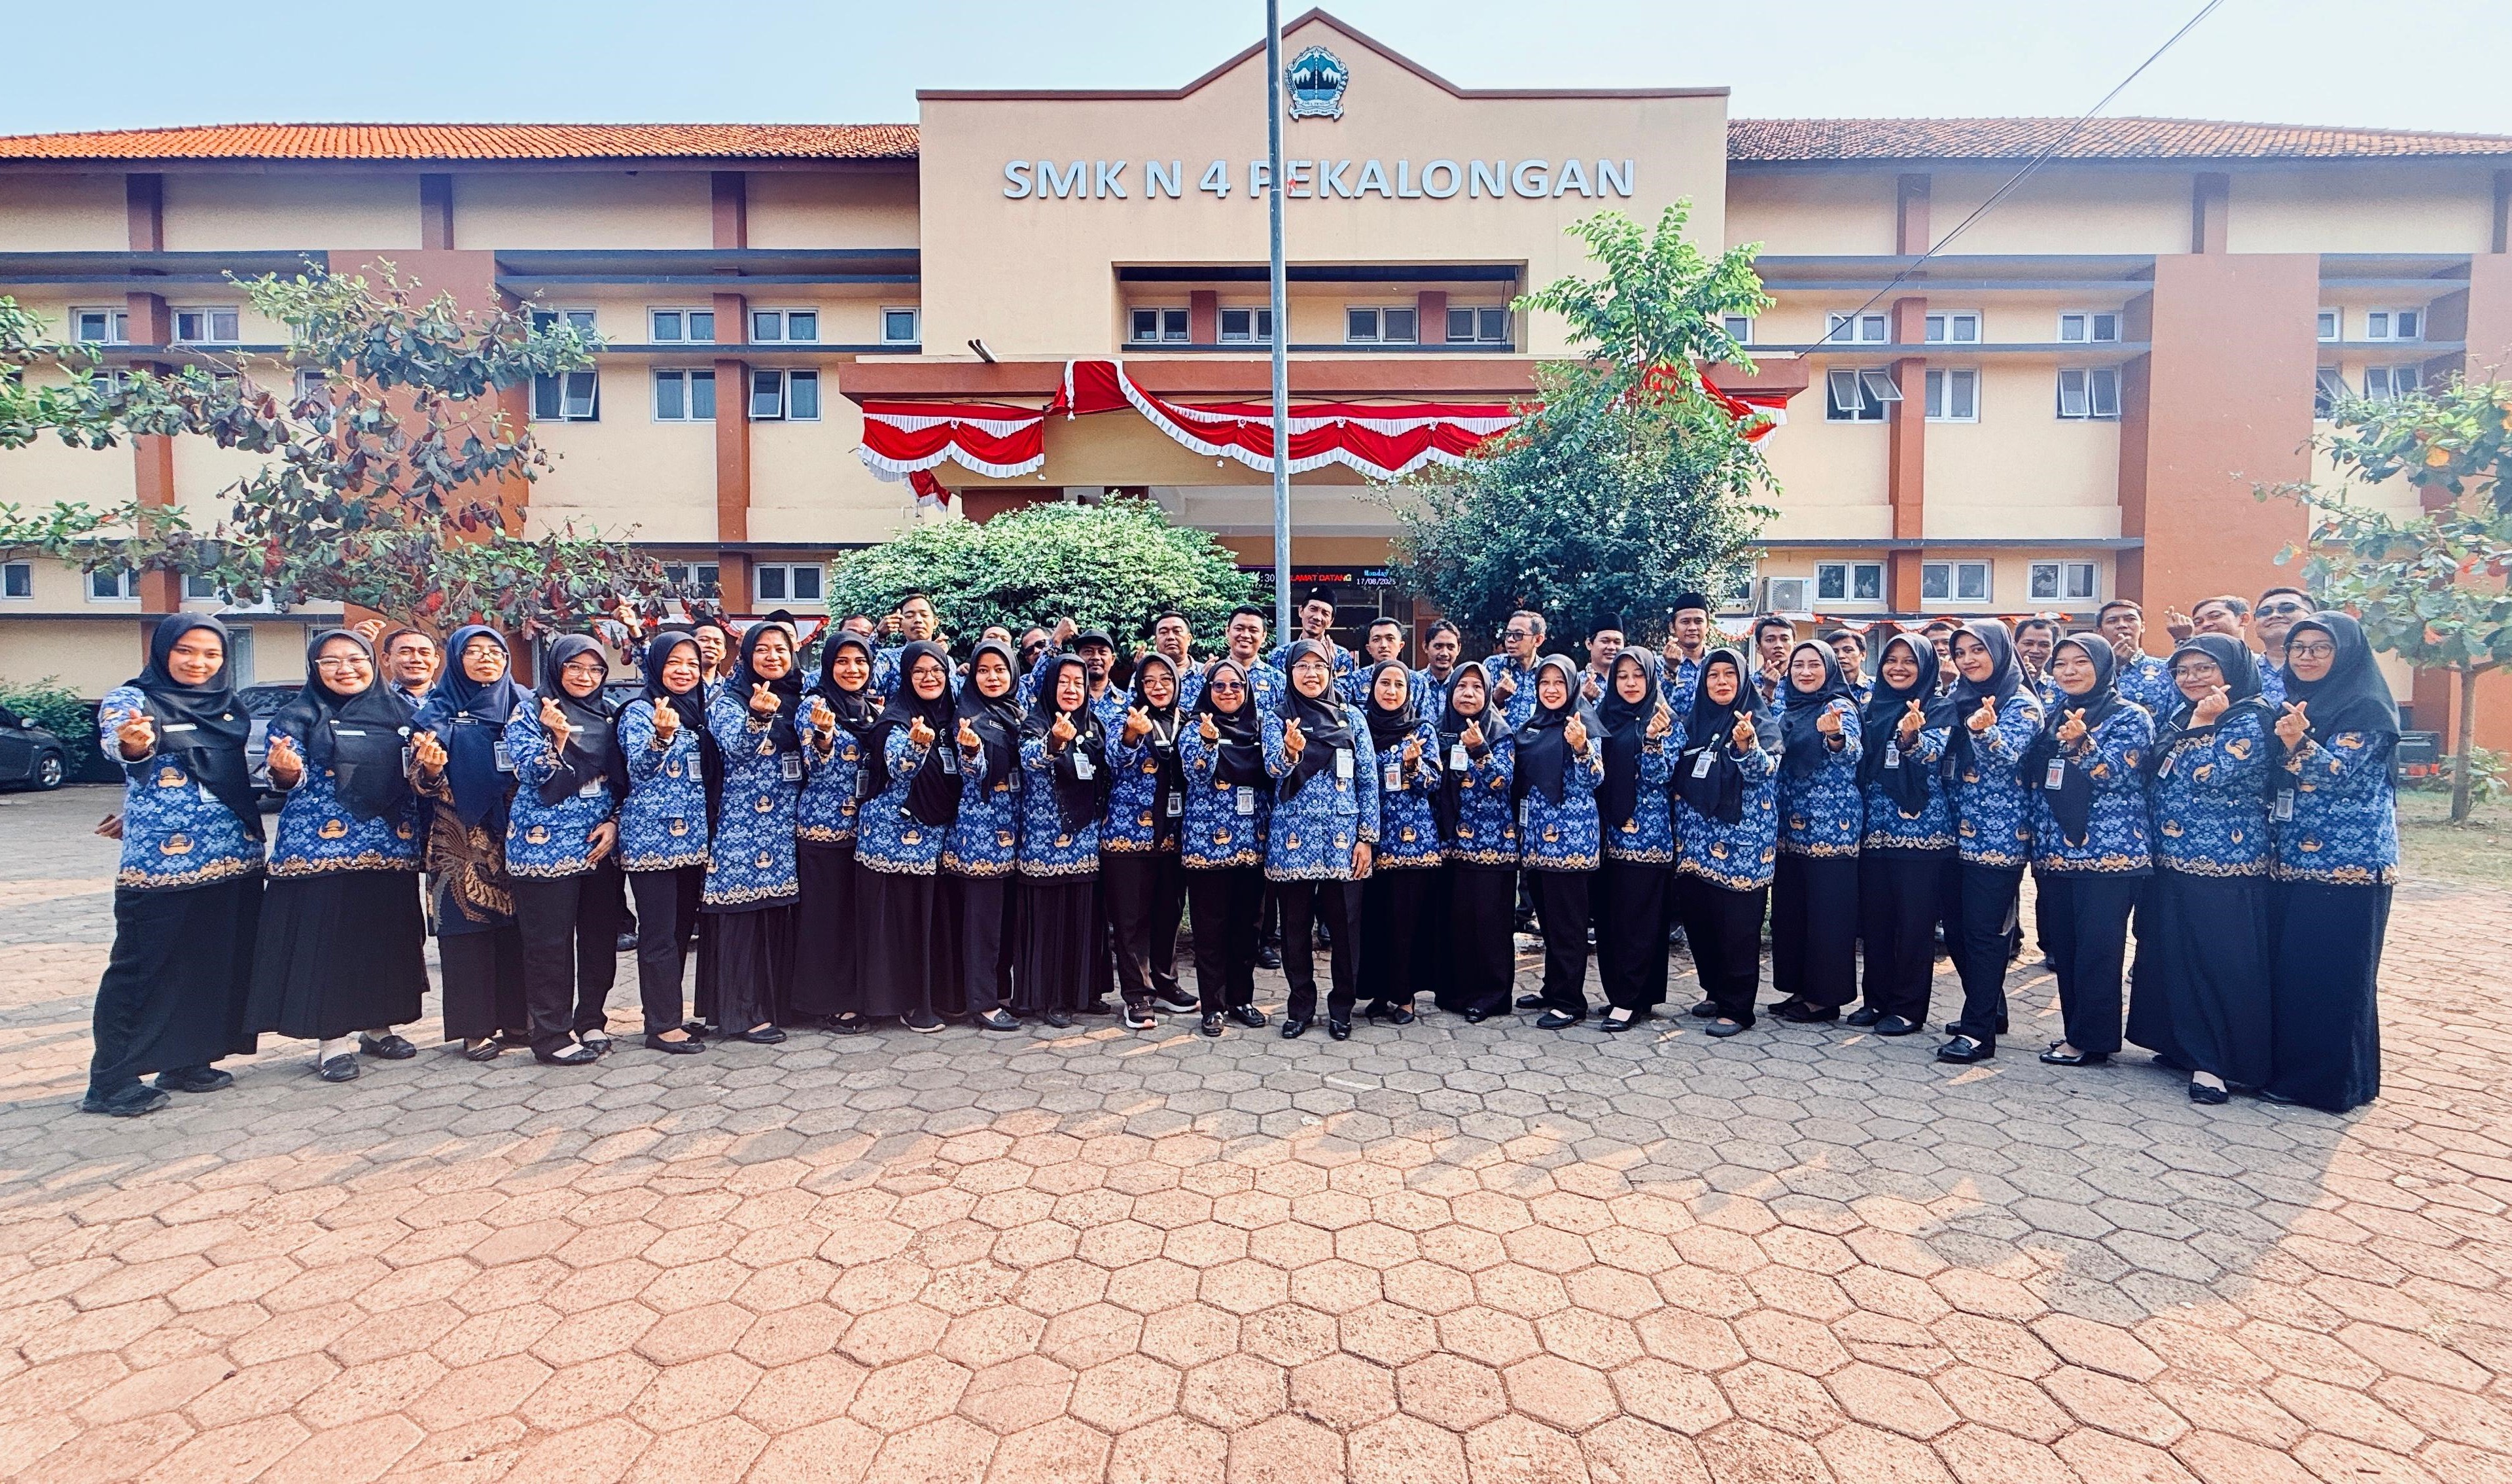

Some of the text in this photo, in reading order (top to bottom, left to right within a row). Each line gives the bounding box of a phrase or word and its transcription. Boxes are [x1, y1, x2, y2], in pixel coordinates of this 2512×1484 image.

[1004, 159, 1635, 200] SMK N 4 PEKALONGAN
[1318, 573, 1352, 582] DATANG
